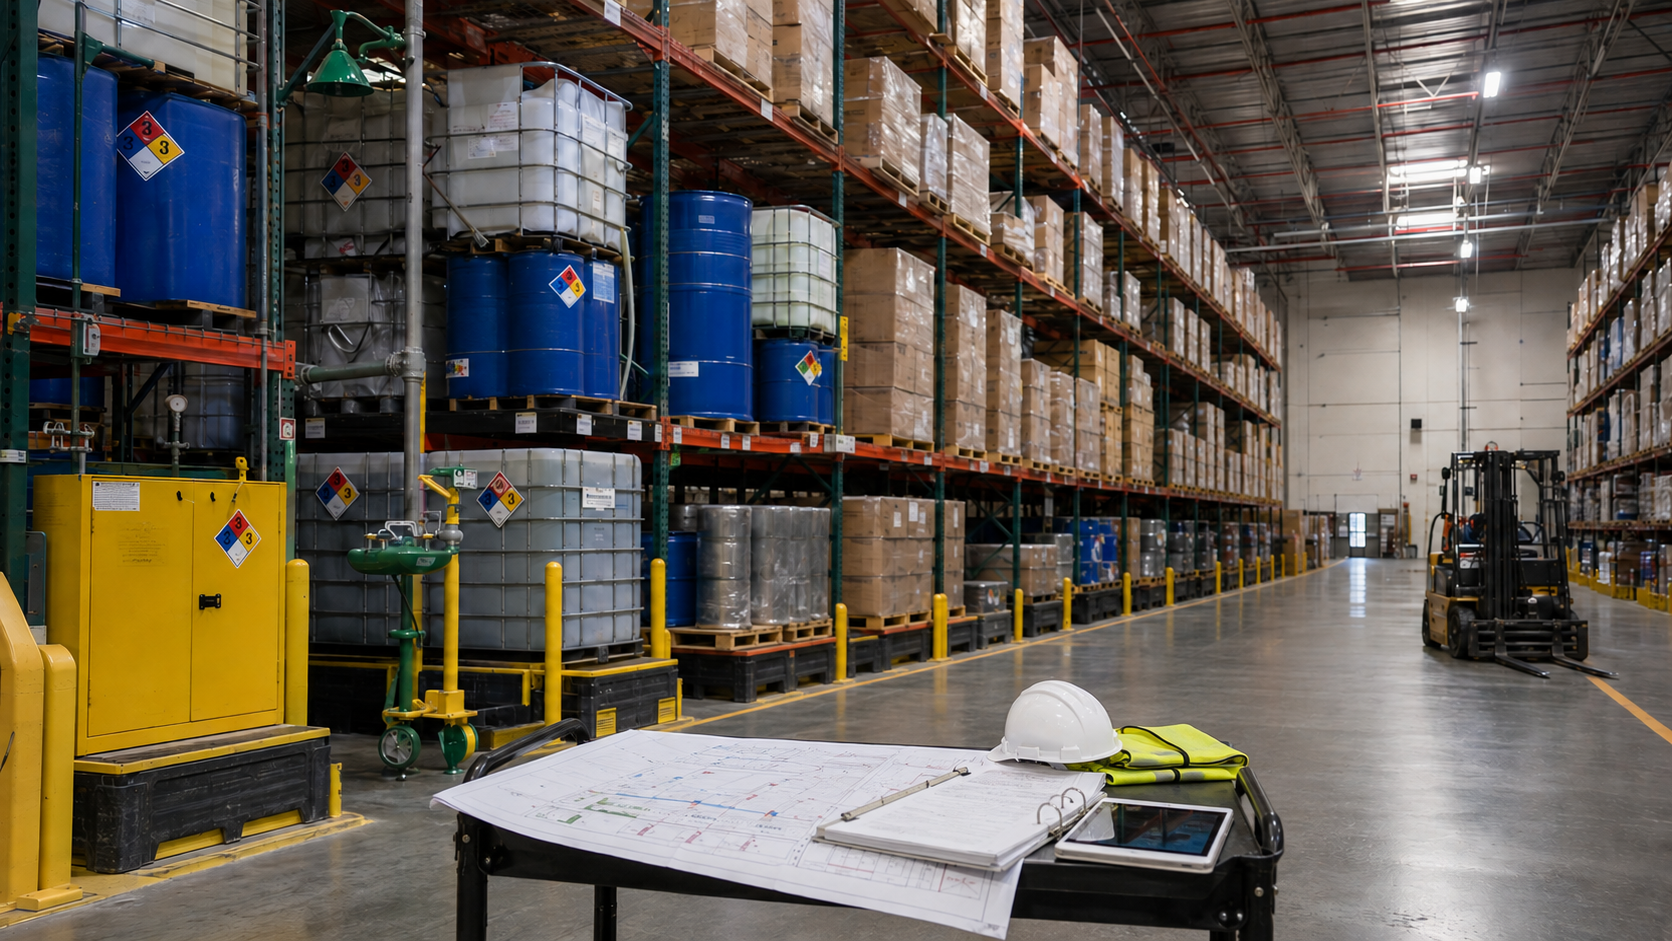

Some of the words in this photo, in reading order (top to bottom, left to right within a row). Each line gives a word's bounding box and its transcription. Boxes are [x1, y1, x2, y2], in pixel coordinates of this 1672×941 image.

[123, 136, 133, 150] 3
[159, 140, 169, 155] 3
[344, 487, 352, 499] 3
[508, 493, 515, 505] 3
[235, 516, 242, 529] 3
[245, 532, 252, 545] 3
